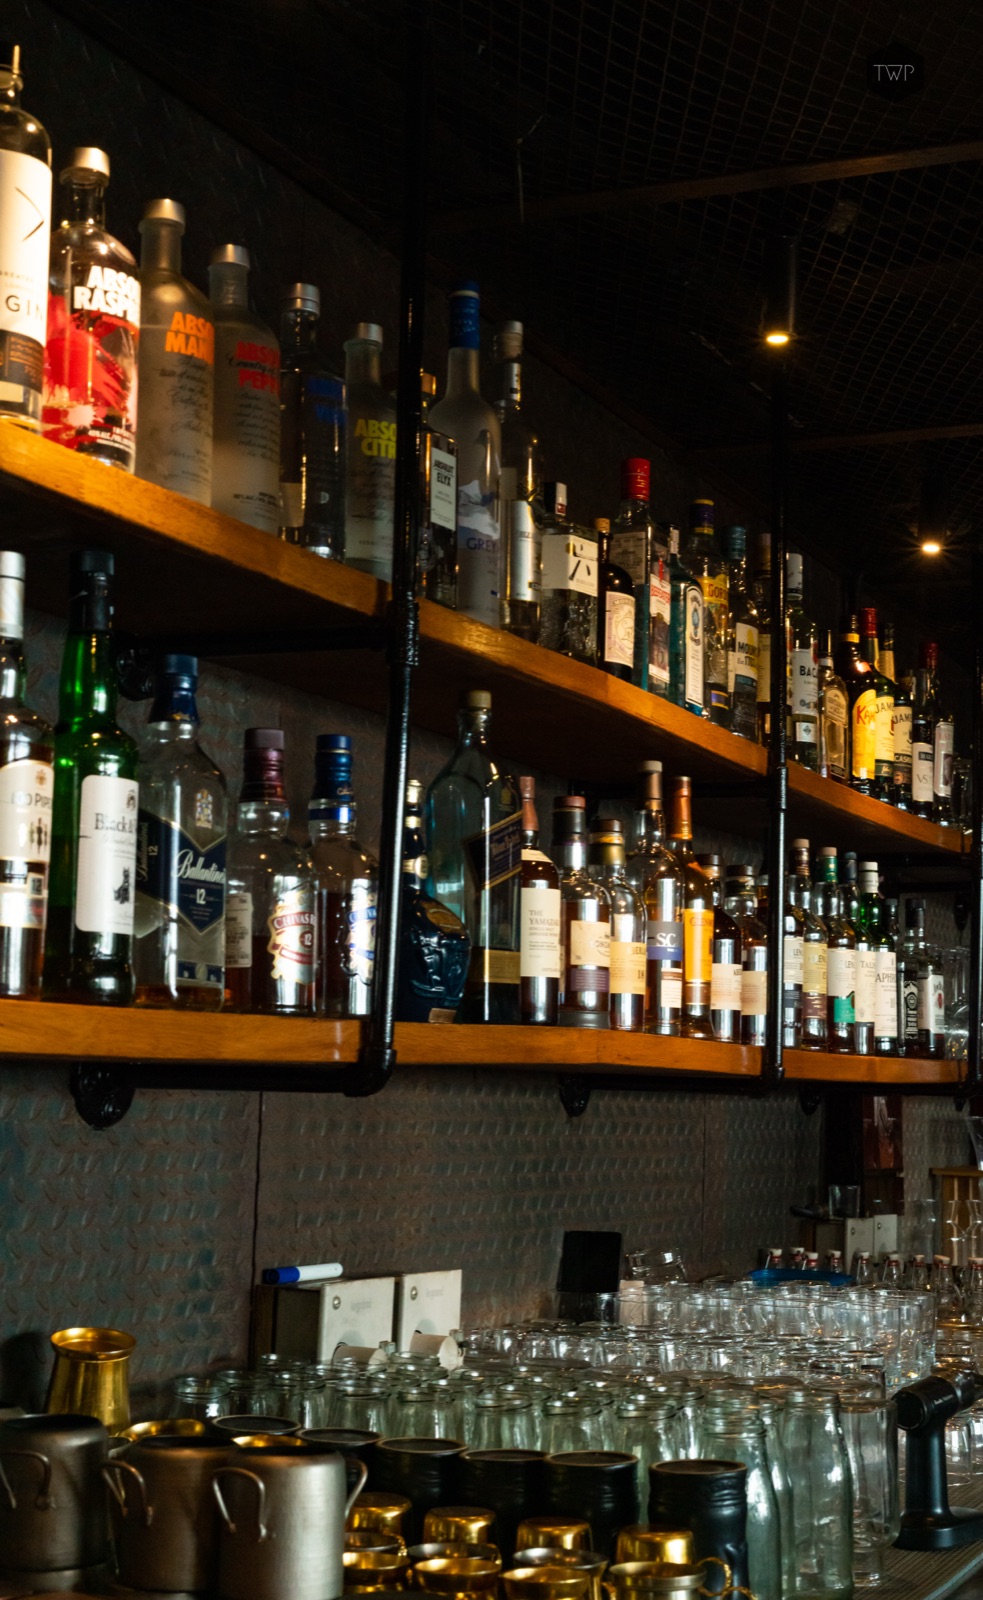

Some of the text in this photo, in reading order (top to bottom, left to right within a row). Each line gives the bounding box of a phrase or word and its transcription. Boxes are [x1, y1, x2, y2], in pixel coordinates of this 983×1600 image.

[5, 294, 43, 320] GIN
[437, 472, 452, 487] ELYX
[466, 537, 497, 554] GREY
[196, 888, 206, 905] 12
[273, 914, 309, 929] CHIVAS
[304, 933, 312, 946] 12
